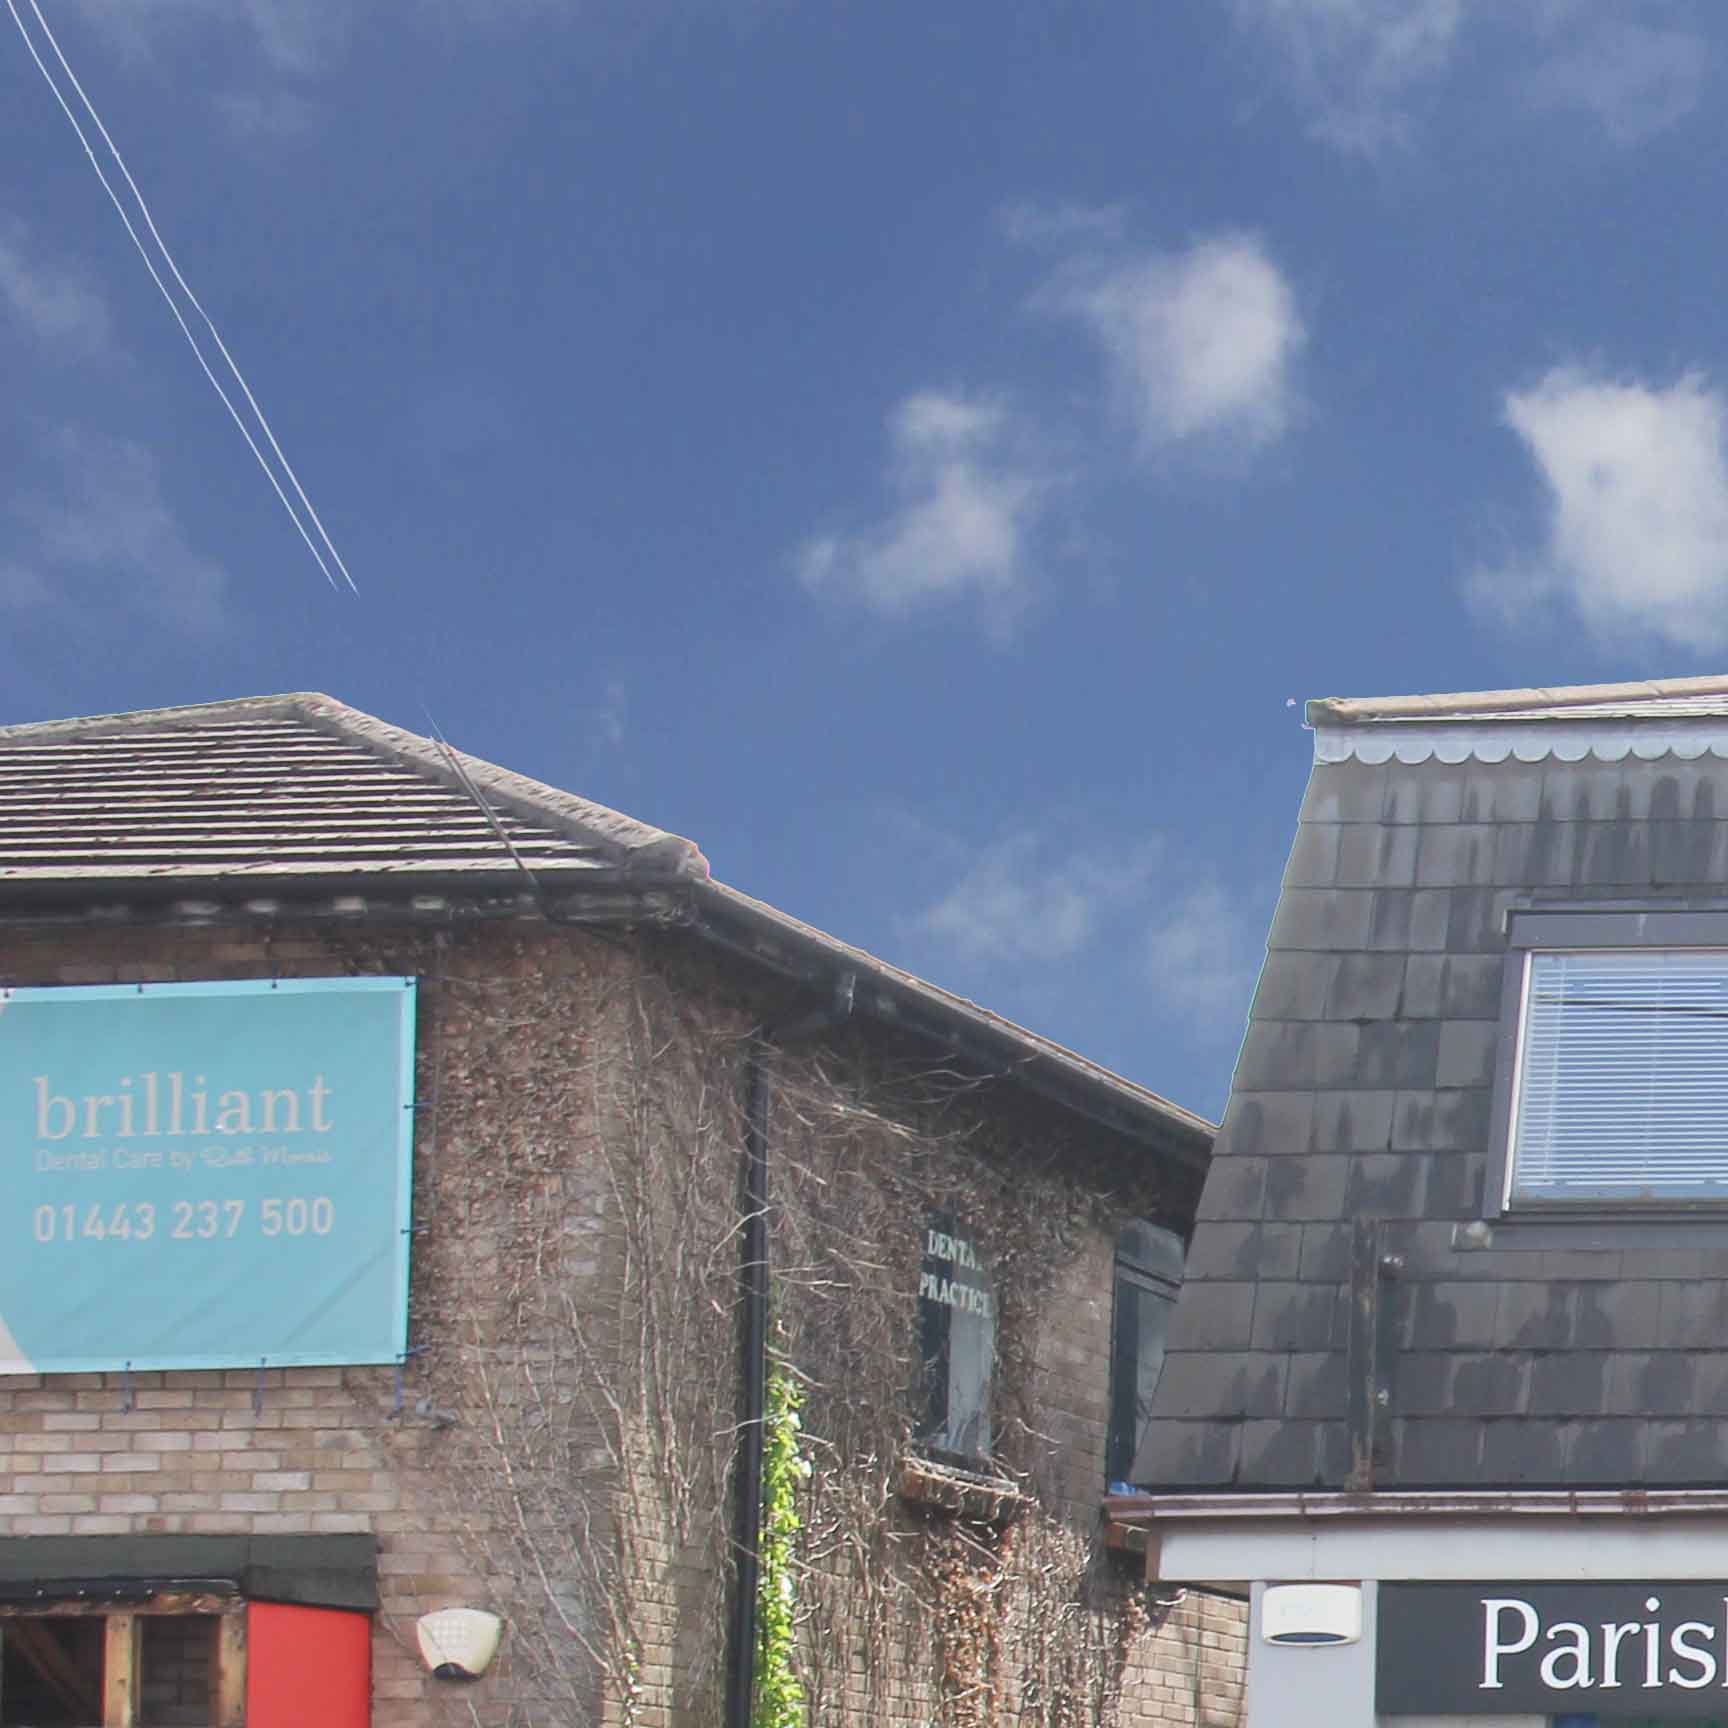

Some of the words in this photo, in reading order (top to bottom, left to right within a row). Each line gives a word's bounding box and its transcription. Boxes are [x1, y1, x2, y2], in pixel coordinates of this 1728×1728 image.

[32, 1071, 334, 1140] brilliant
[32, 1203, 155, 1243] 01443
[170, 1200, 245, 1239] 237
[261, 1197, 334, 1236] 500
[927, 1229, 984, 1271] DENTA
